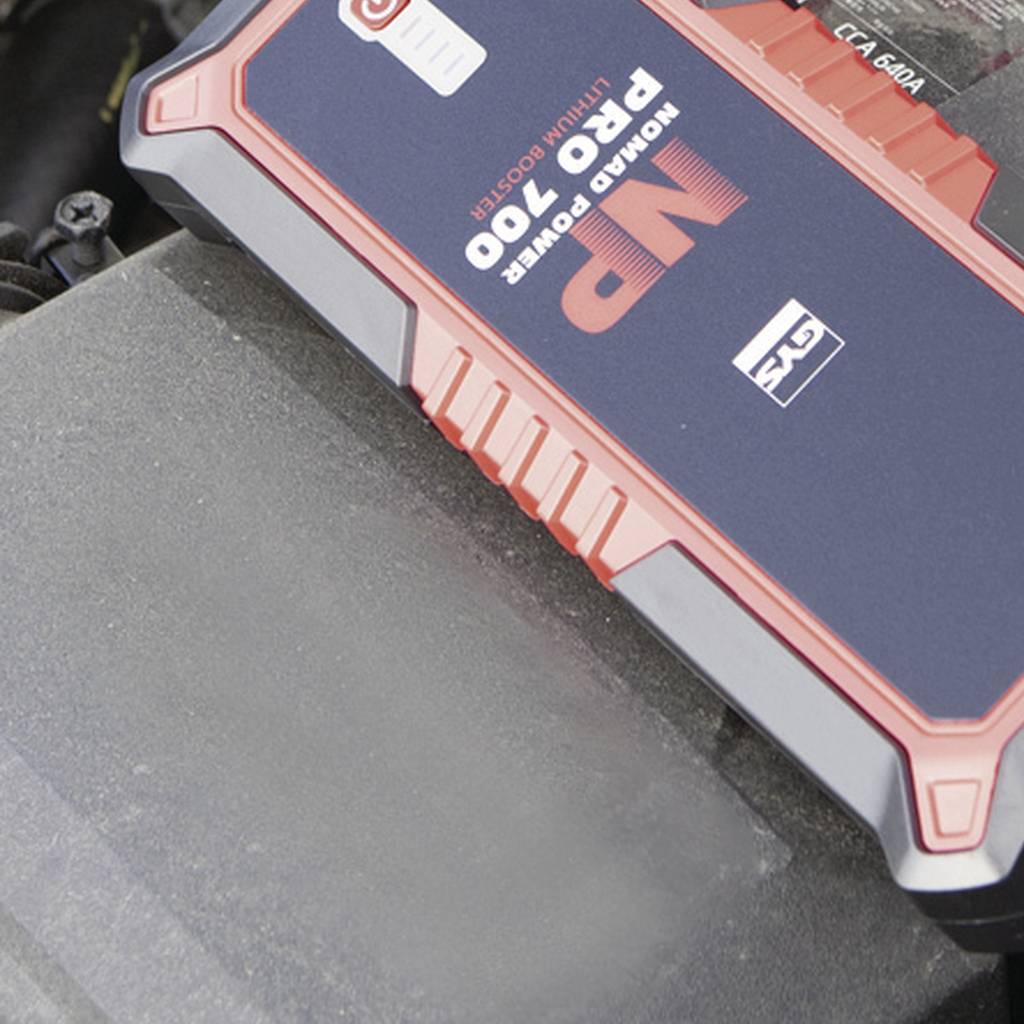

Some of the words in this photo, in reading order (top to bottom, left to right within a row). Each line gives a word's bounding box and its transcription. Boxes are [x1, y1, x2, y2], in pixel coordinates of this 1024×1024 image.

[833, 22, 877, 58] CCA
[873, 52, 925, 95] 640A
[541, 76, 612, 146] LITHIUM
[557, 66, 664, 175] PRO
[589, 101, 681, 194] NOMAD
[465, 178, 559, 270] 700
[470, 144, 545, 221] BOOSTER
[500, 193, 591, 285] POWER
[561, 136, 749, 334] NP
